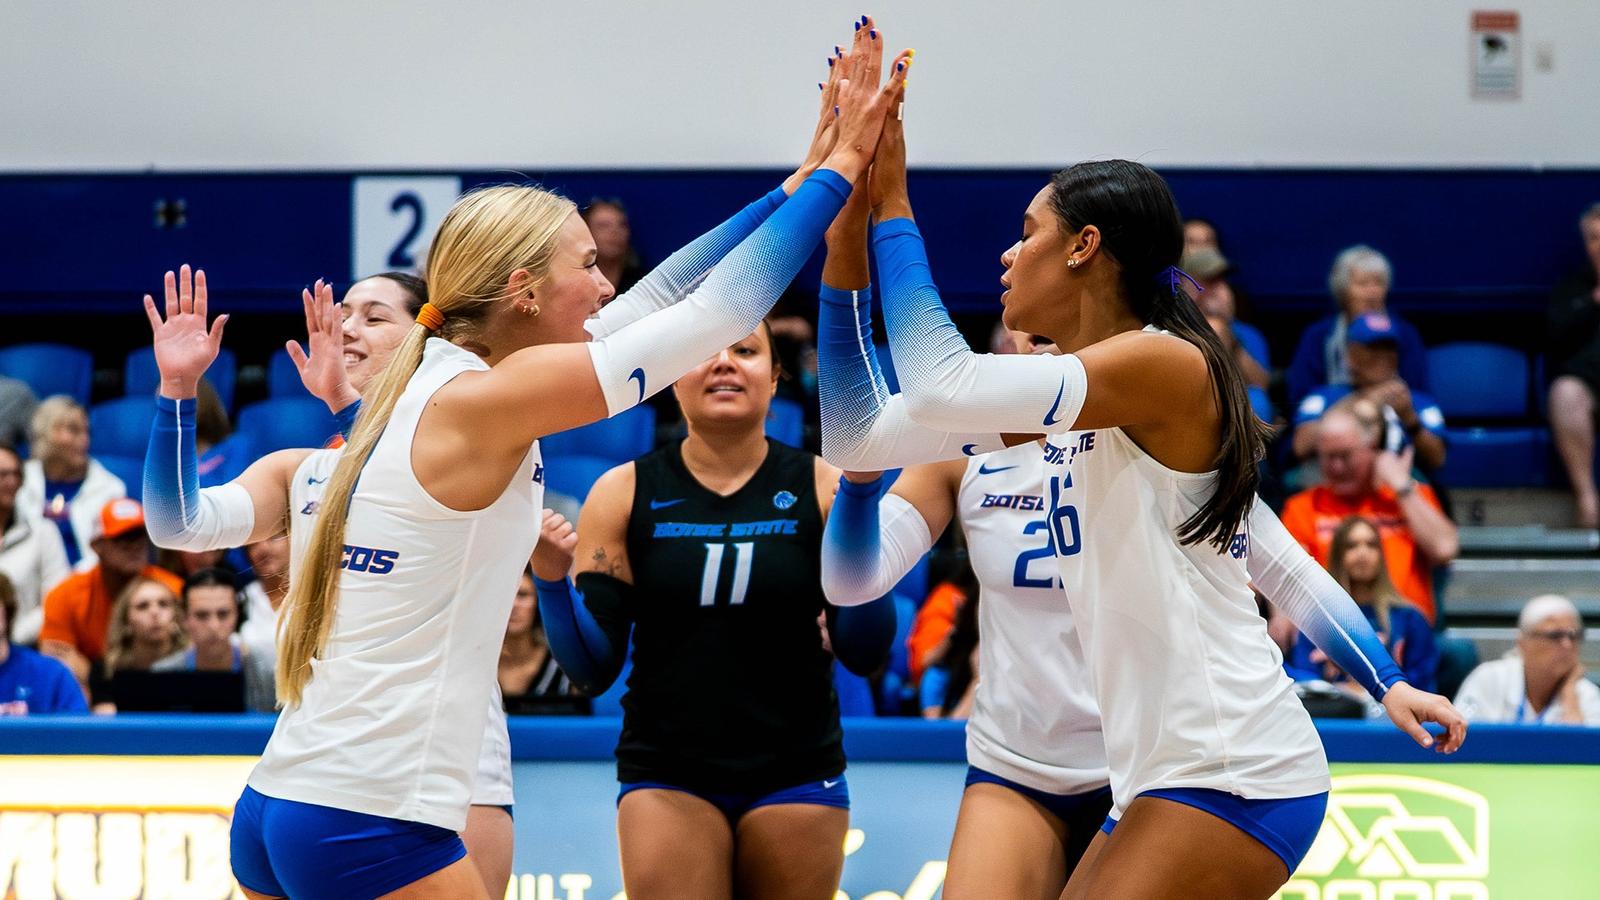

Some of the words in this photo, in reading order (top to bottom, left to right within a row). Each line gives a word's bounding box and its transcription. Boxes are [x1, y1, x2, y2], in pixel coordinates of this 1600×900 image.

[387, 193, 424, 268] 2
[653, 522, 727, 538] BOISE
[729, 519, 799, 537] STATE
[1013, 520, 1064, 589] 2
[700, 542, 754, 606] 11
